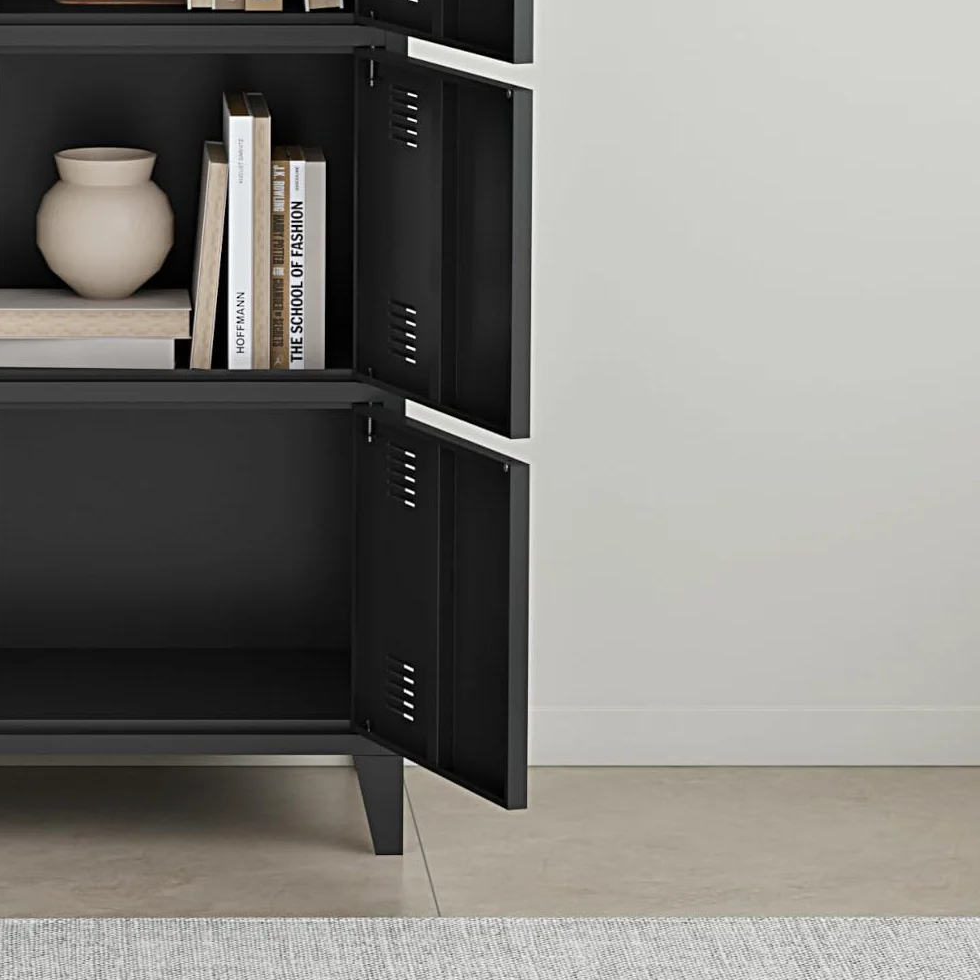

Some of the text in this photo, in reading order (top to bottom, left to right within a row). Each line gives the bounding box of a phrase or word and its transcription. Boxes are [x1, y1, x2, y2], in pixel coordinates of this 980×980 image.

[273, 180, 285, 212] ROWLING
[272, 214, 284, 237] HARRY
[272, 239, 284, 265] POTTER
[272, 278, 284, 311] CHAMBER
[290, 201, 303, 363] THE SCHOOL OF FASHION
[236, 291, 245, 354] HOFFMANN
[272, 318, 284, 347] SECRETS
